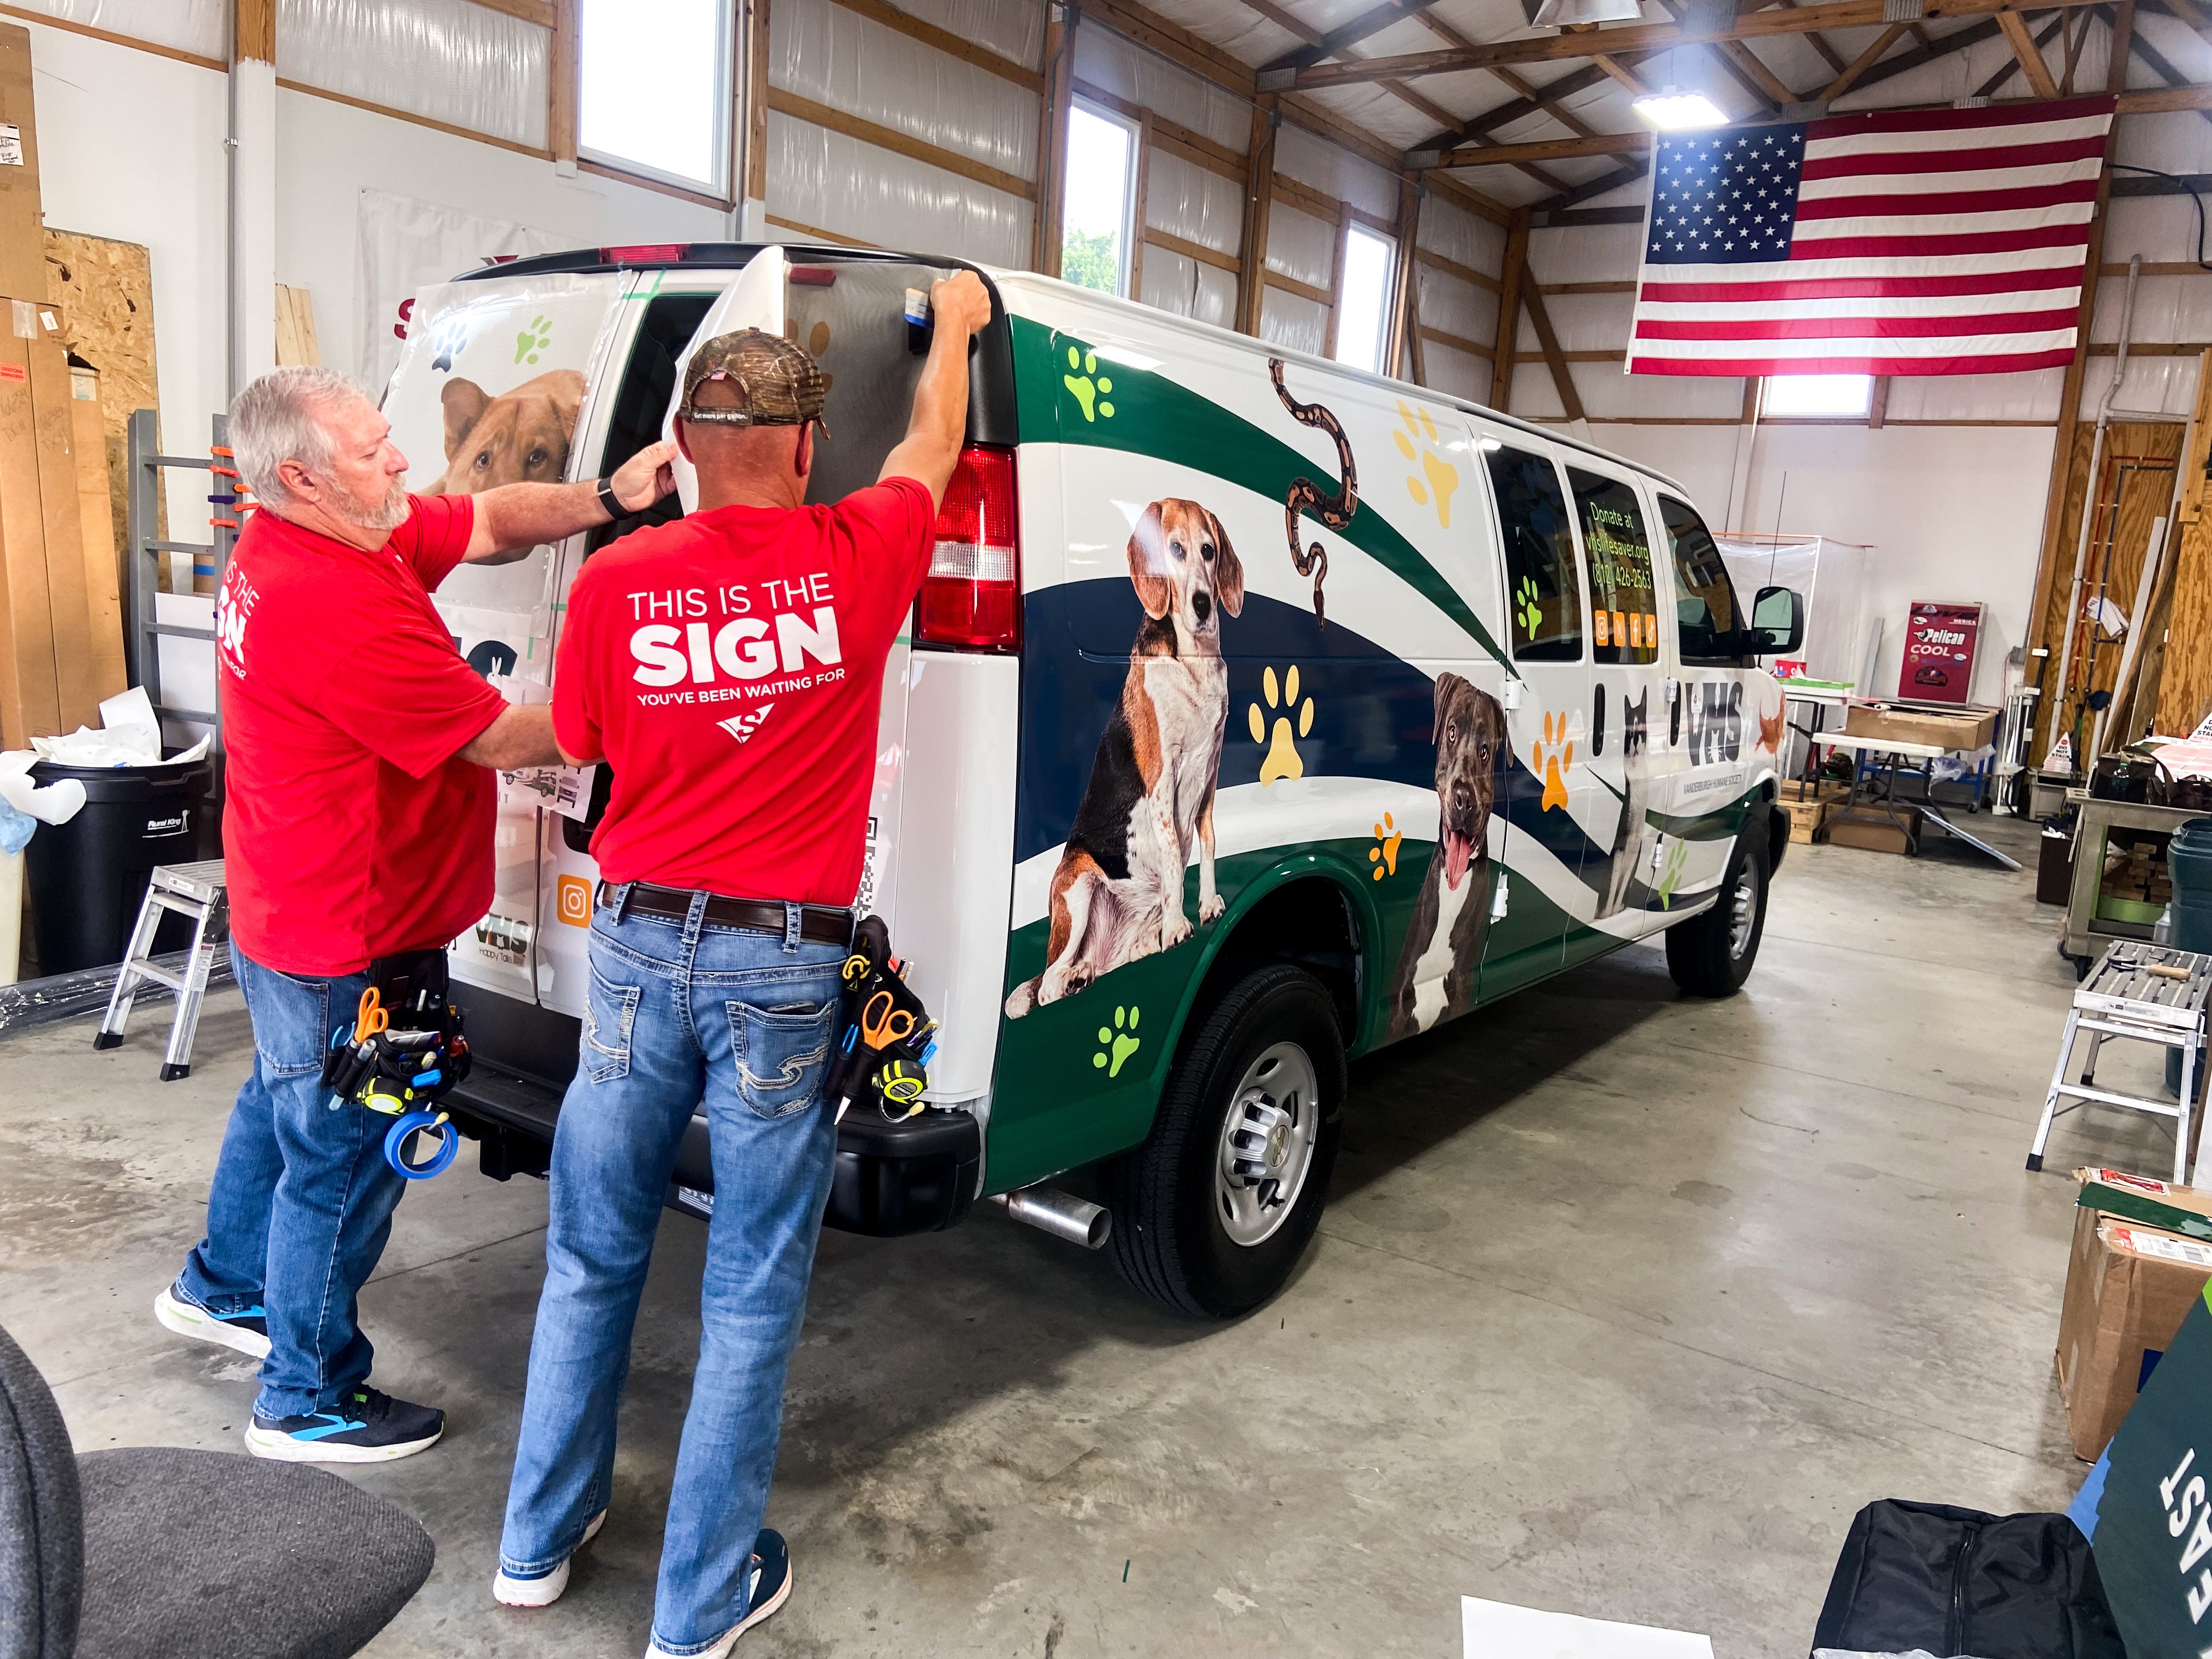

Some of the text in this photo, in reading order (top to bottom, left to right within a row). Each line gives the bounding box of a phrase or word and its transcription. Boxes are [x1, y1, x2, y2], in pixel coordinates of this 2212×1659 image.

[1590, 501, 1634, 529] Donate at
[1585, 531, 1649, 566] vhslifesaver.org
[1593, 562, 1651, 590] (812) 426-2563
[234, 571, 261, 617] THE
[627, 572, 834, 620] THIS IS THE
[630, 606, 842, 687] SIGN
[1910, 644, 1951, 657] COOL
[1925, 628, 1965, 646] Pelican
[637, 668, 845, 707] YOU'VE BEEN WAITING FOR
[1685, 681, 1743, 766] VHS
[148, 820, 167, 828] Rural
[479, 946, 512, 964] Happy Tails
